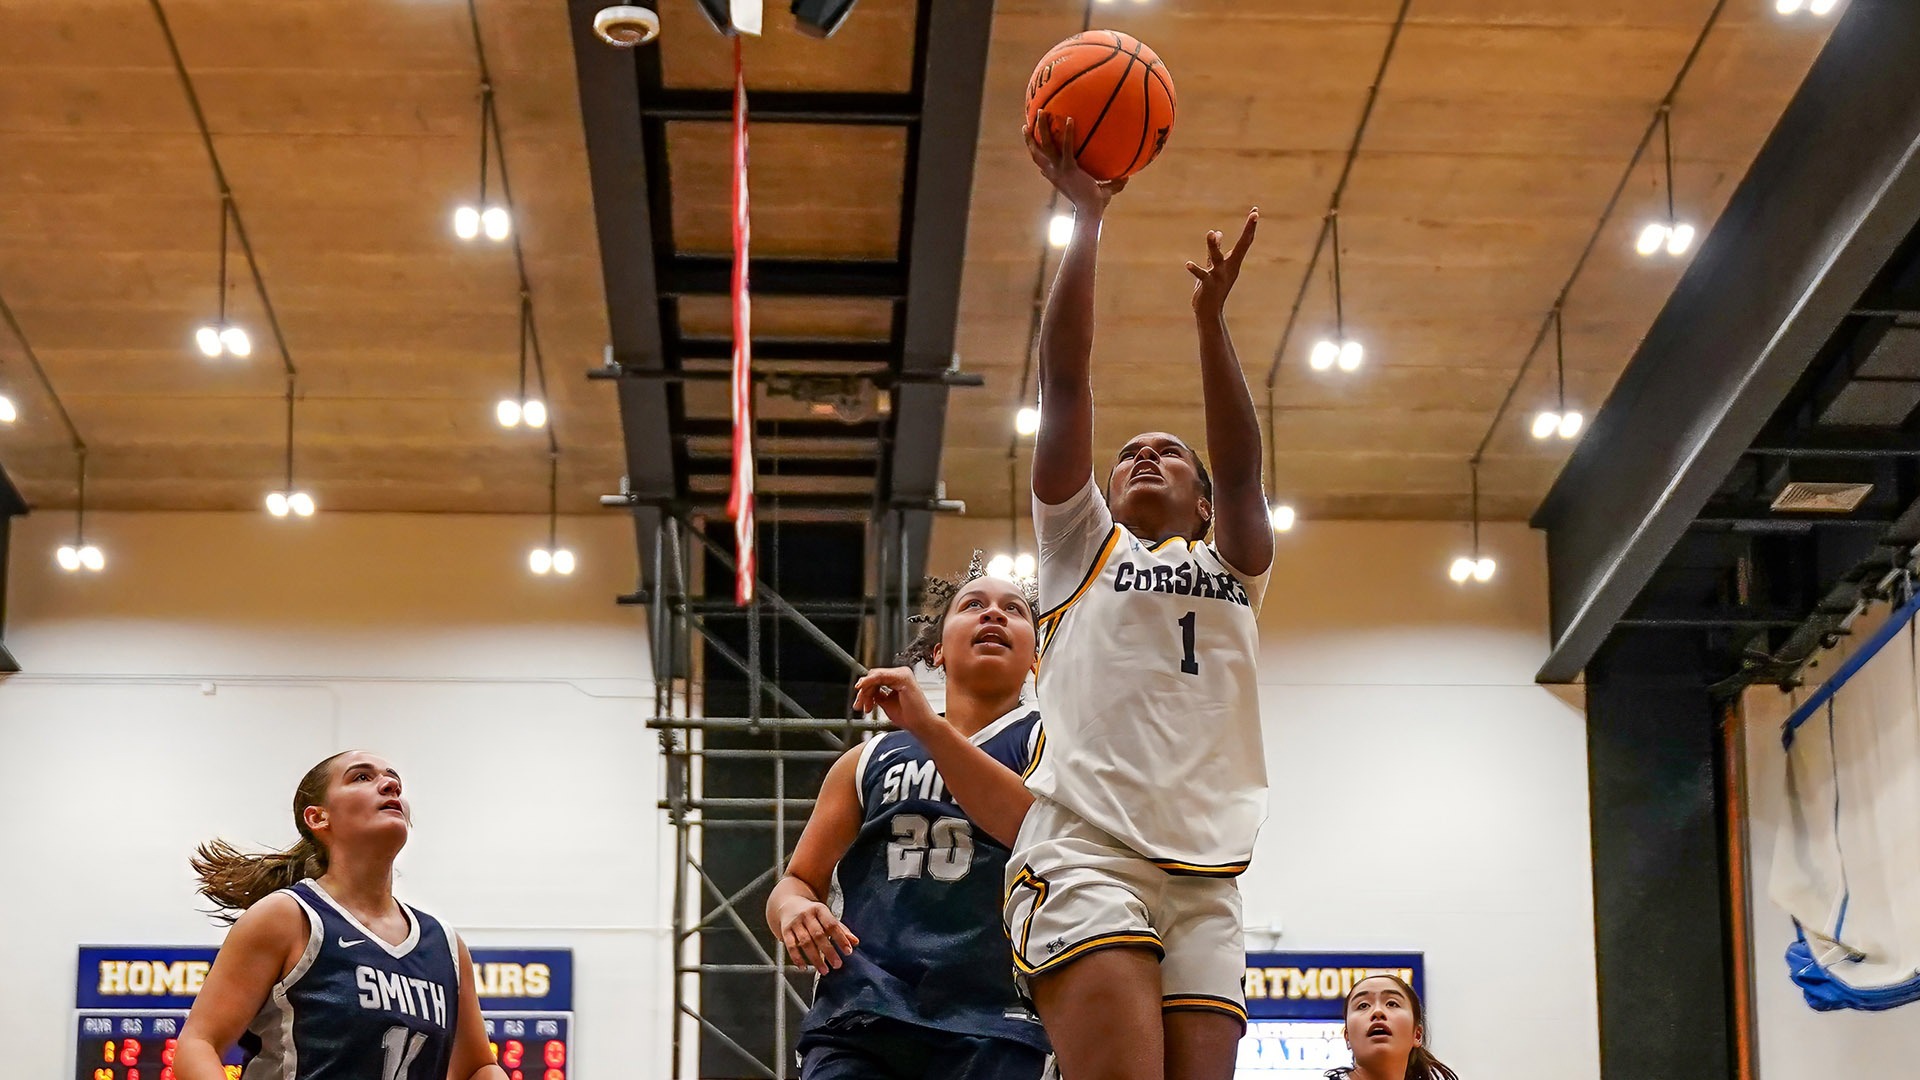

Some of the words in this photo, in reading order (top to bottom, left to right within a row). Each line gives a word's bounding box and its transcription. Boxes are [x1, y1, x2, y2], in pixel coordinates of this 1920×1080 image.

[1178, 611, 1198, 675] 1
[887, 814, 974, 881] 20
[98, 960, 211, 995] HOME
[355, 965, 447, 1029] SMITH
[120, 1038, 141, 1067] 2
[503, 1040, 524, 1069] 2
